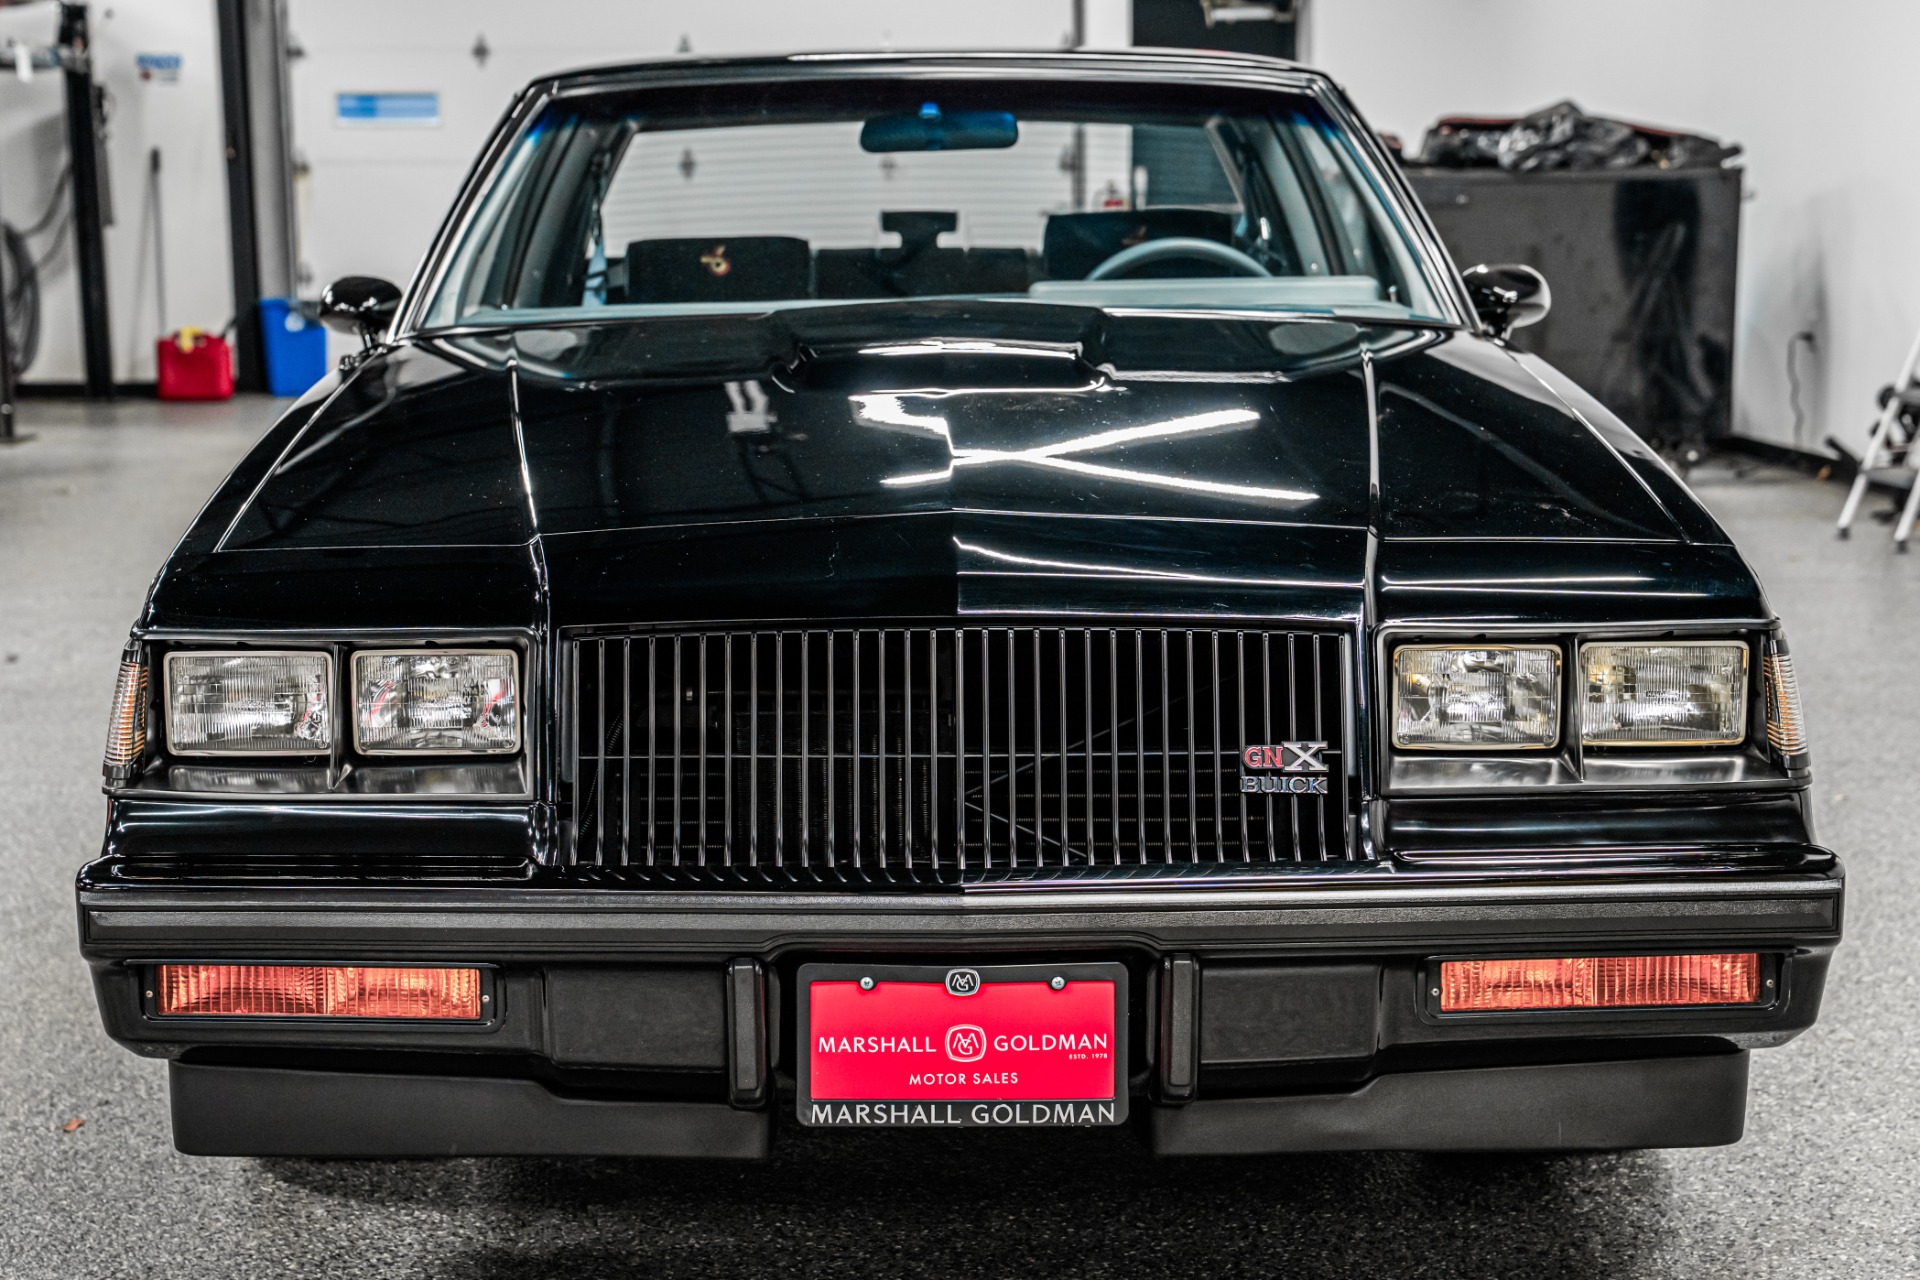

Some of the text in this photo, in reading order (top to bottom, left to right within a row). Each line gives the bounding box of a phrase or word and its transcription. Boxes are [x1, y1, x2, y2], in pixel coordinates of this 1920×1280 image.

[1244, 741, 1328, 772] GNX
[1240, 776, 1328, 794] BUICK
[818, 1036, 937, 1053] MARSHALL
[993, 1033, 1108, 1051] GOLDMAN
[909, 1072, 1019, 1085] MOTOR SALES
[811, 1103, 1115, 1124] MARSHALL GOLDMAN
